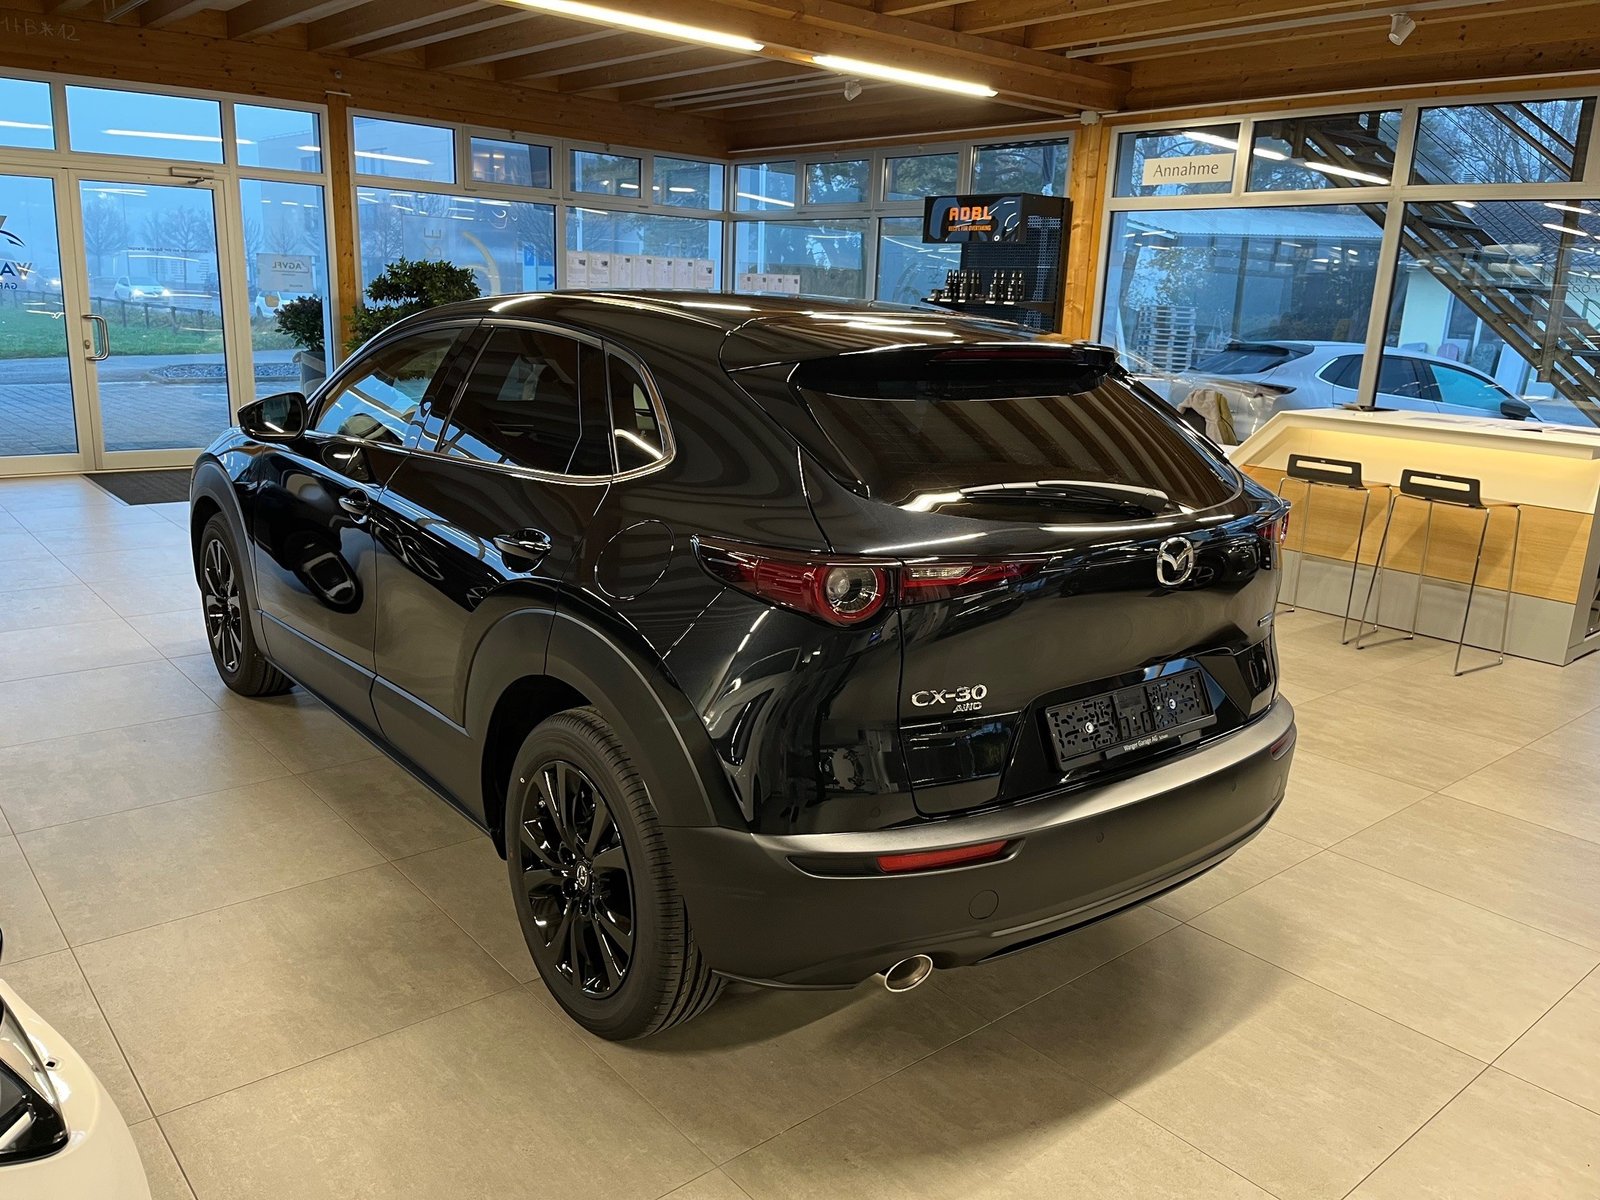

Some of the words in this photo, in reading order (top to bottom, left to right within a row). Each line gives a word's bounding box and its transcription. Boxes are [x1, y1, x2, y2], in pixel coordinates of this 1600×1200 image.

[1153, 162, 1219, 178] Annahme
[949, 206, 992, 221] ADBL
[911, 684, 988, 707] CX-30
[952, 701, 983, 714] AWD
